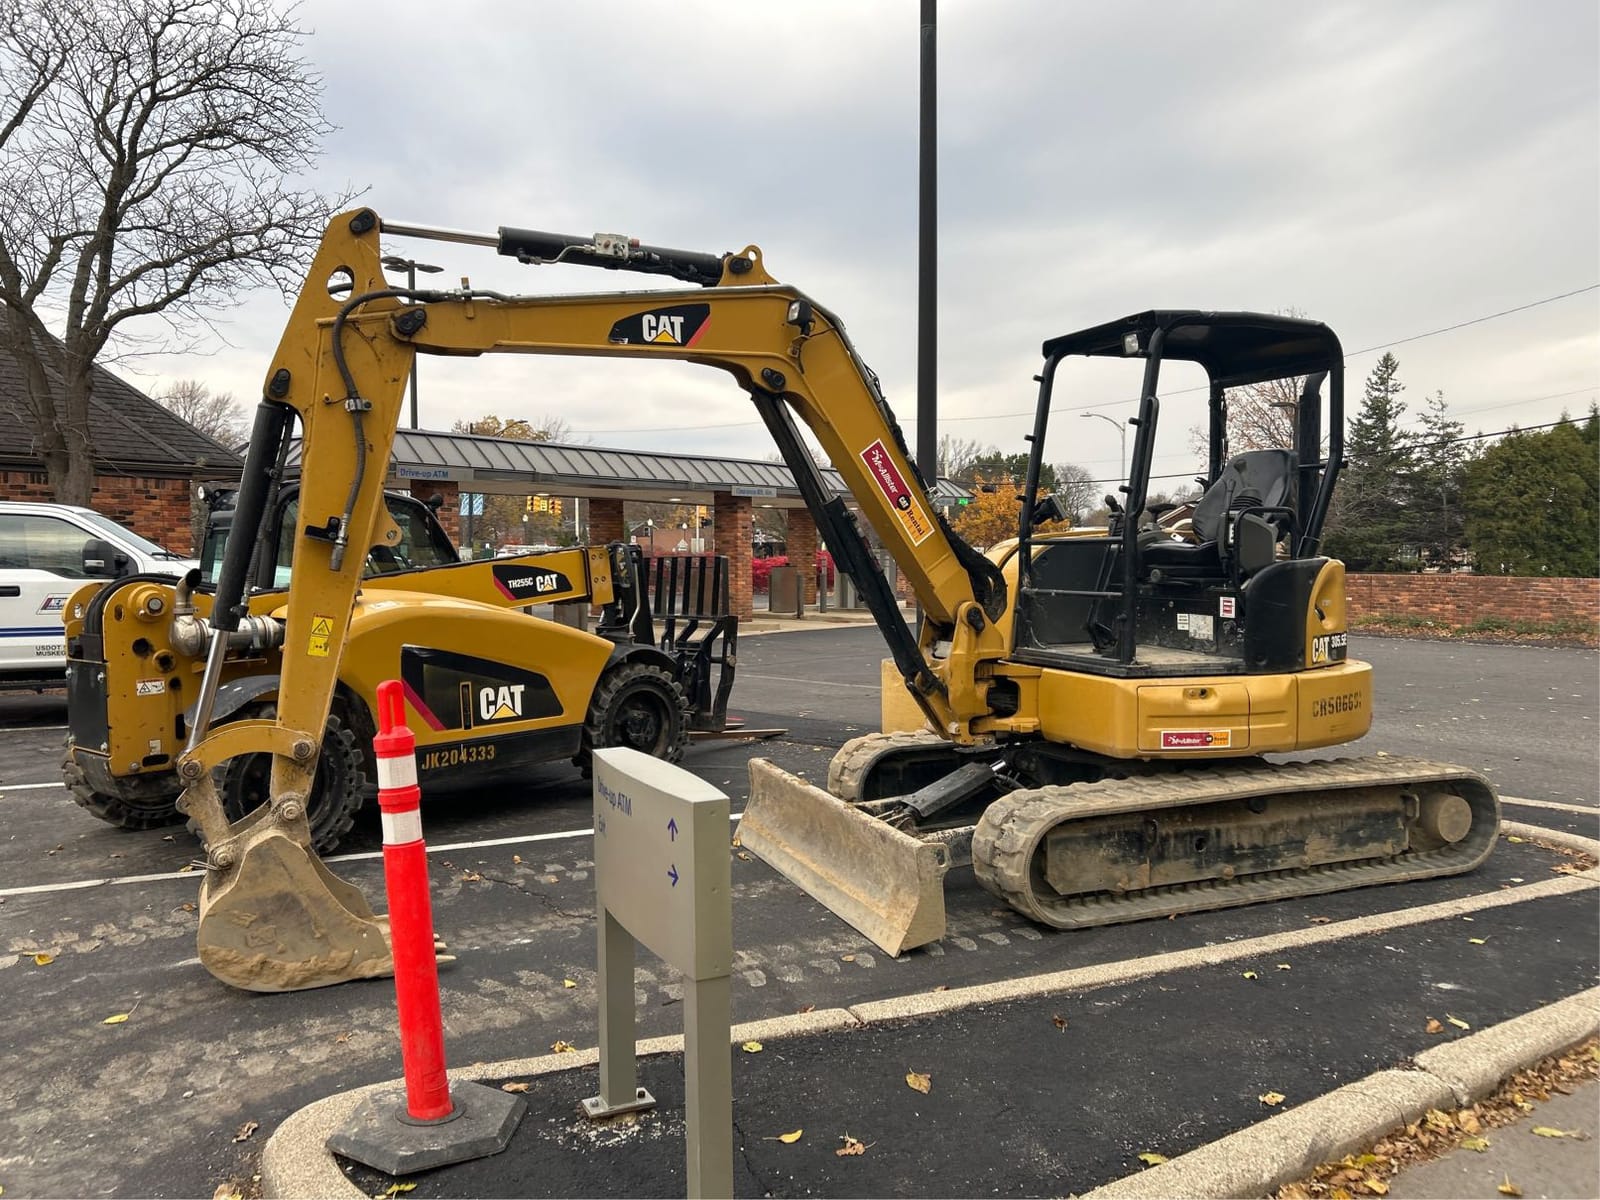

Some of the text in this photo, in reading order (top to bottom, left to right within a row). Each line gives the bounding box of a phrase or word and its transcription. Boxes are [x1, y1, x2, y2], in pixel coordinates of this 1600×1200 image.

[642, 313, 684, 344] CAT
[400, 468, 449, 478] Drive-up ATM
[906, 509, 925, 536] Rental
[508, 574, 558, 592] TH255C CAT
[1312, 637, 1330, 662] CAT
[479, 684, 525, 720] CAT
[421, 744, 496, 770] JK204333
